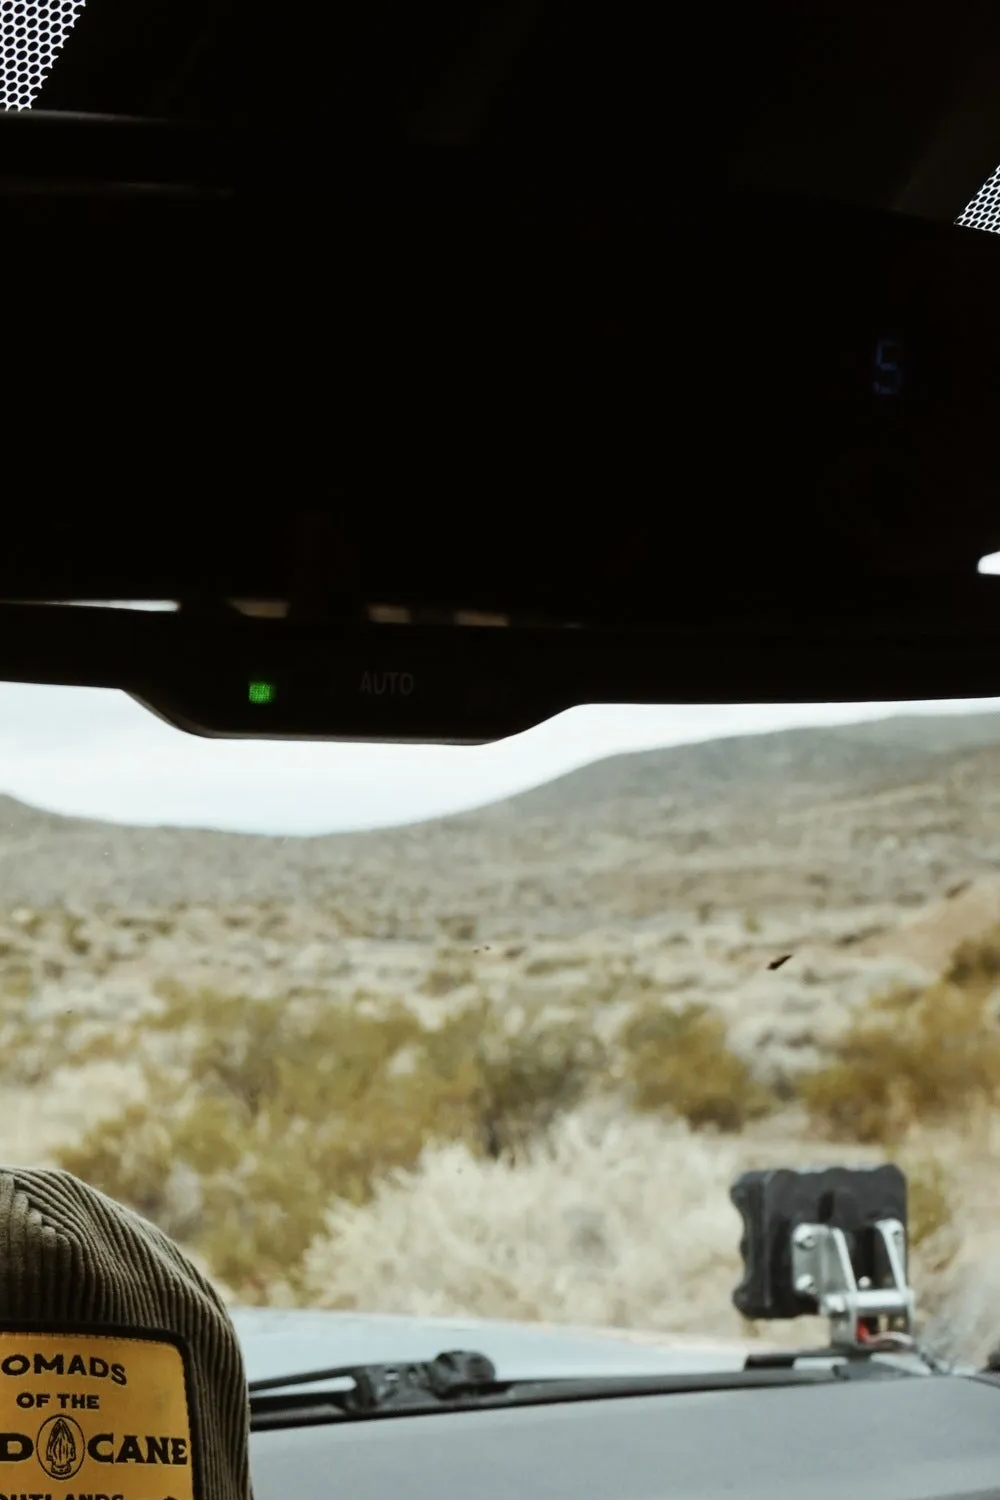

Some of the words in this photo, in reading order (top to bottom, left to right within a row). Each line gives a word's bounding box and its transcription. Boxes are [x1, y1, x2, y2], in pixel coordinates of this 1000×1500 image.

[359, 670, 414, 695] AUTO
[16, 1392, 50, 1408] OF
[57, 1394, 100, 1410] THE
[87, 1434, 188, 1465] CANE
